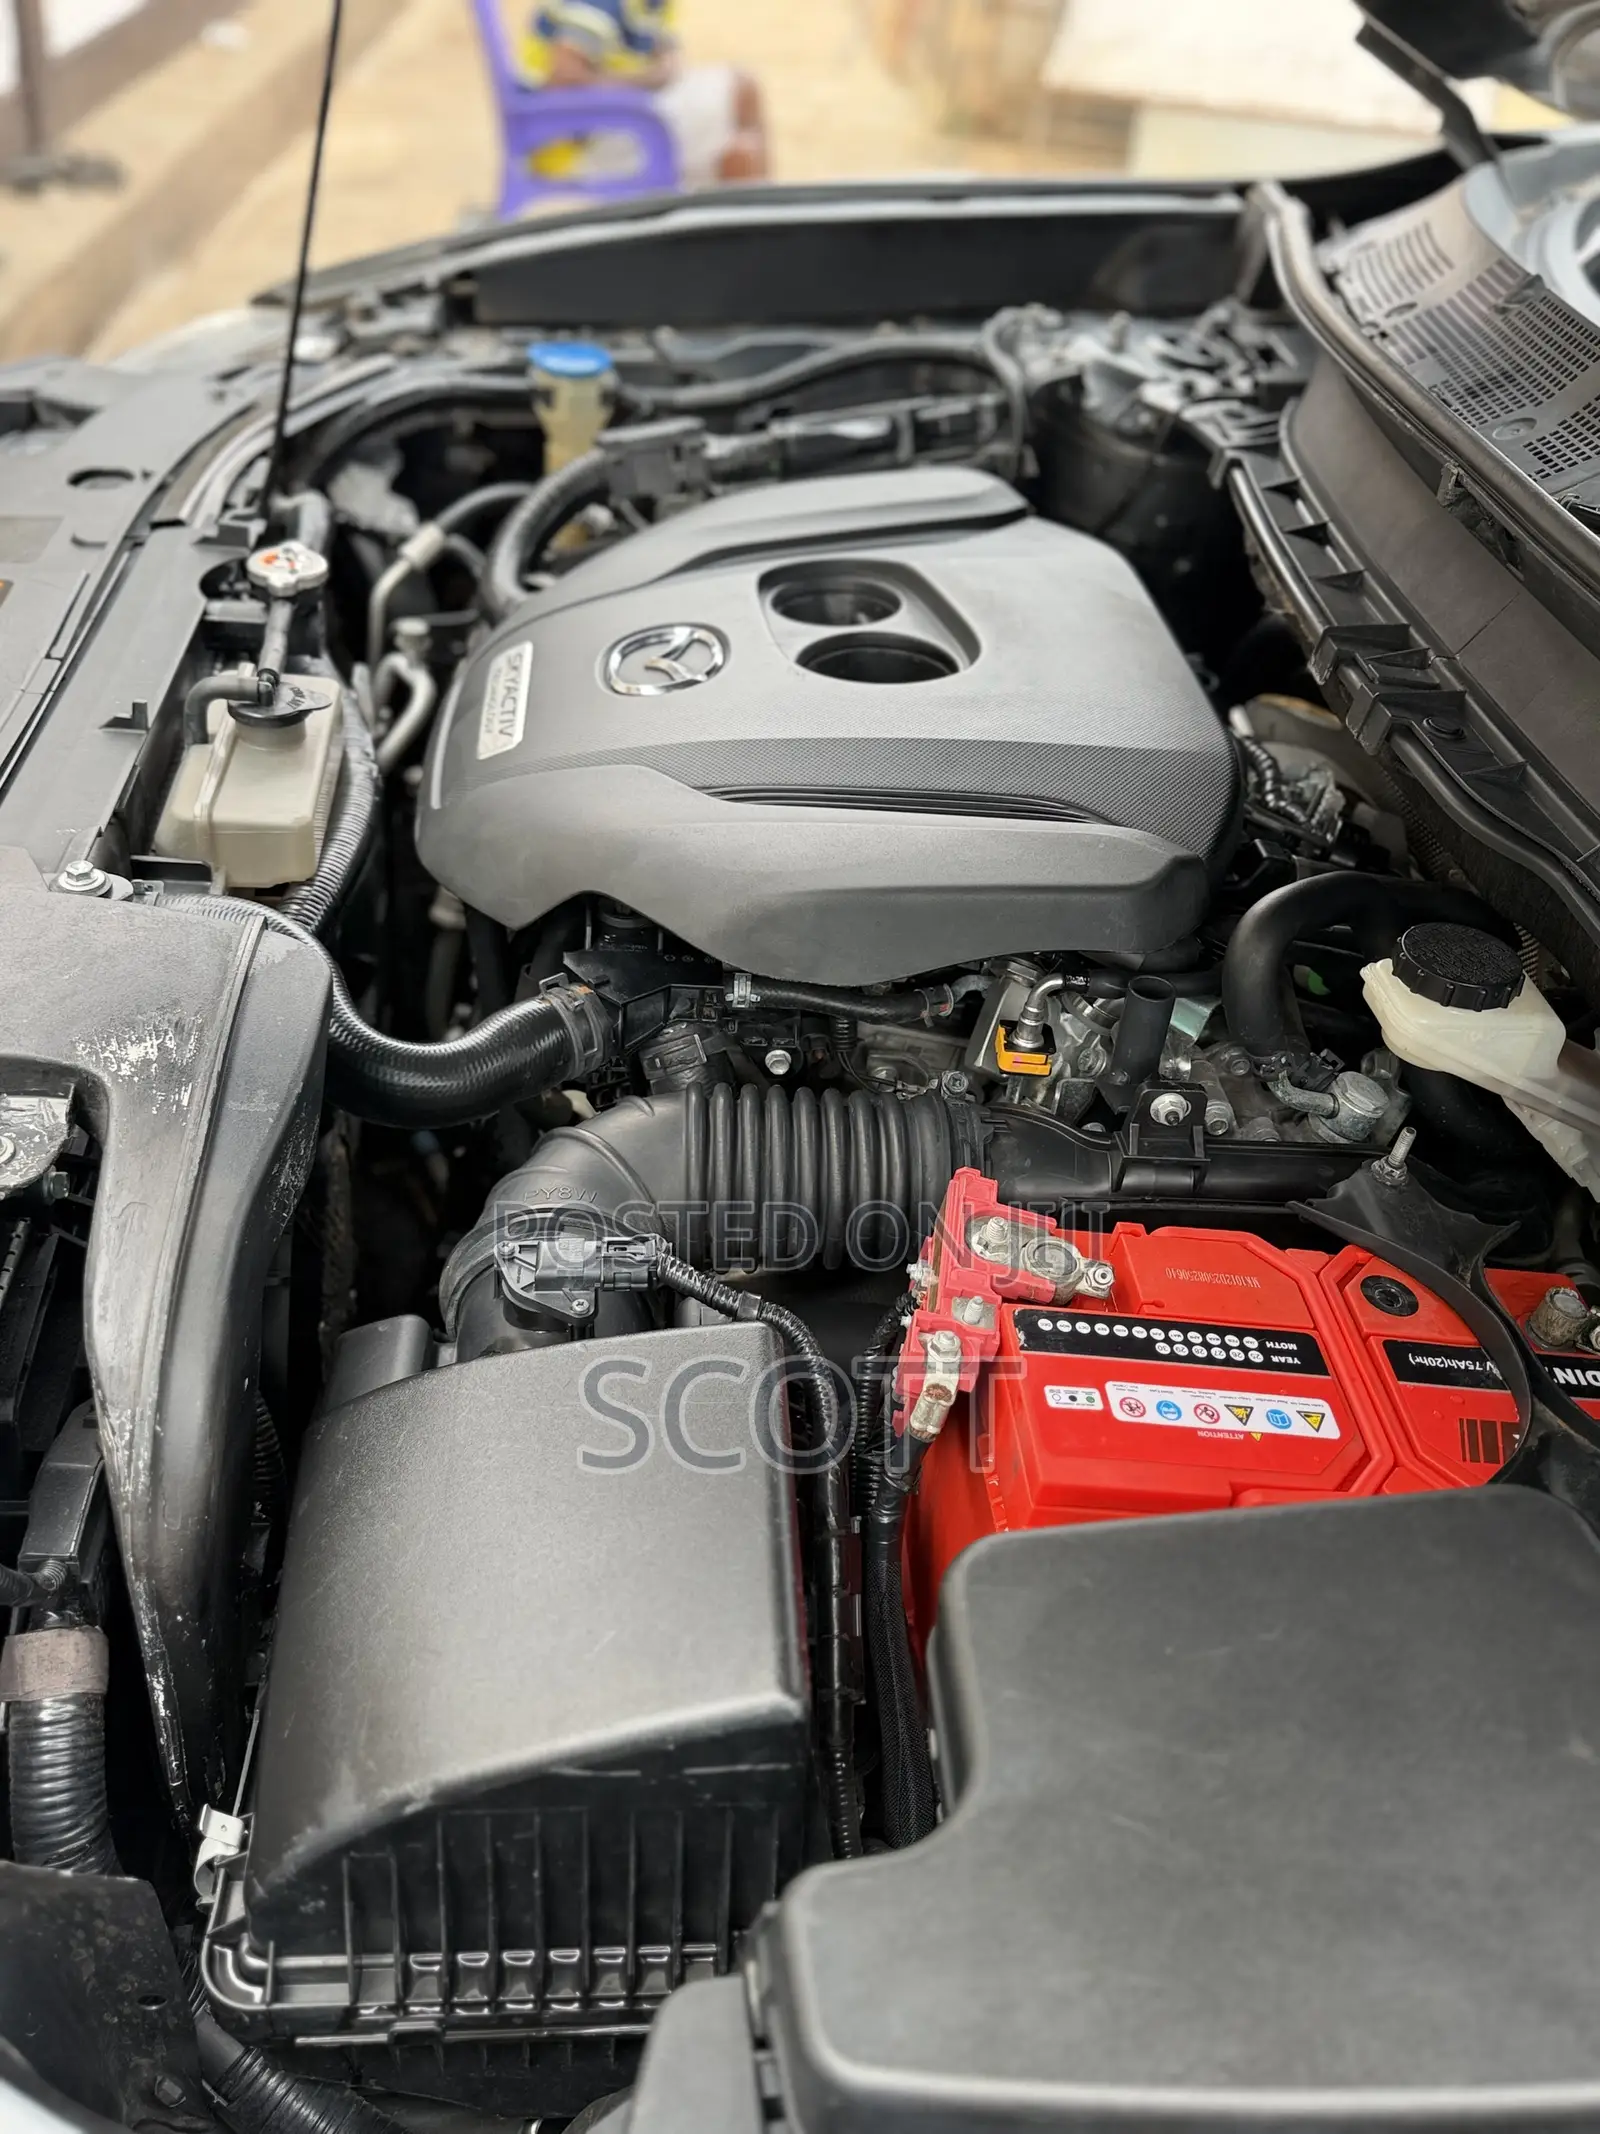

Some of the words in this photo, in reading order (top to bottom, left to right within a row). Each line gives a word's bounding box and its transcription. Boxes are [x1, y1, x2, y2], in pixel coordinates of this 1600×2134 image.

[498, 652, 523, 737] SKYACTIV
[523, 1185, 598, 1203] PY8W
[1265, 1340, 1298, 1350] MOTH
[1270, 1354, 1301, 1365] YEAR
[1408, 1353, 1484, 1371] 75Ah(20hr)
[1544, 1366, 1600, 1387] DIN
[1196, 1430, 1245, 1440] ATTENTION
